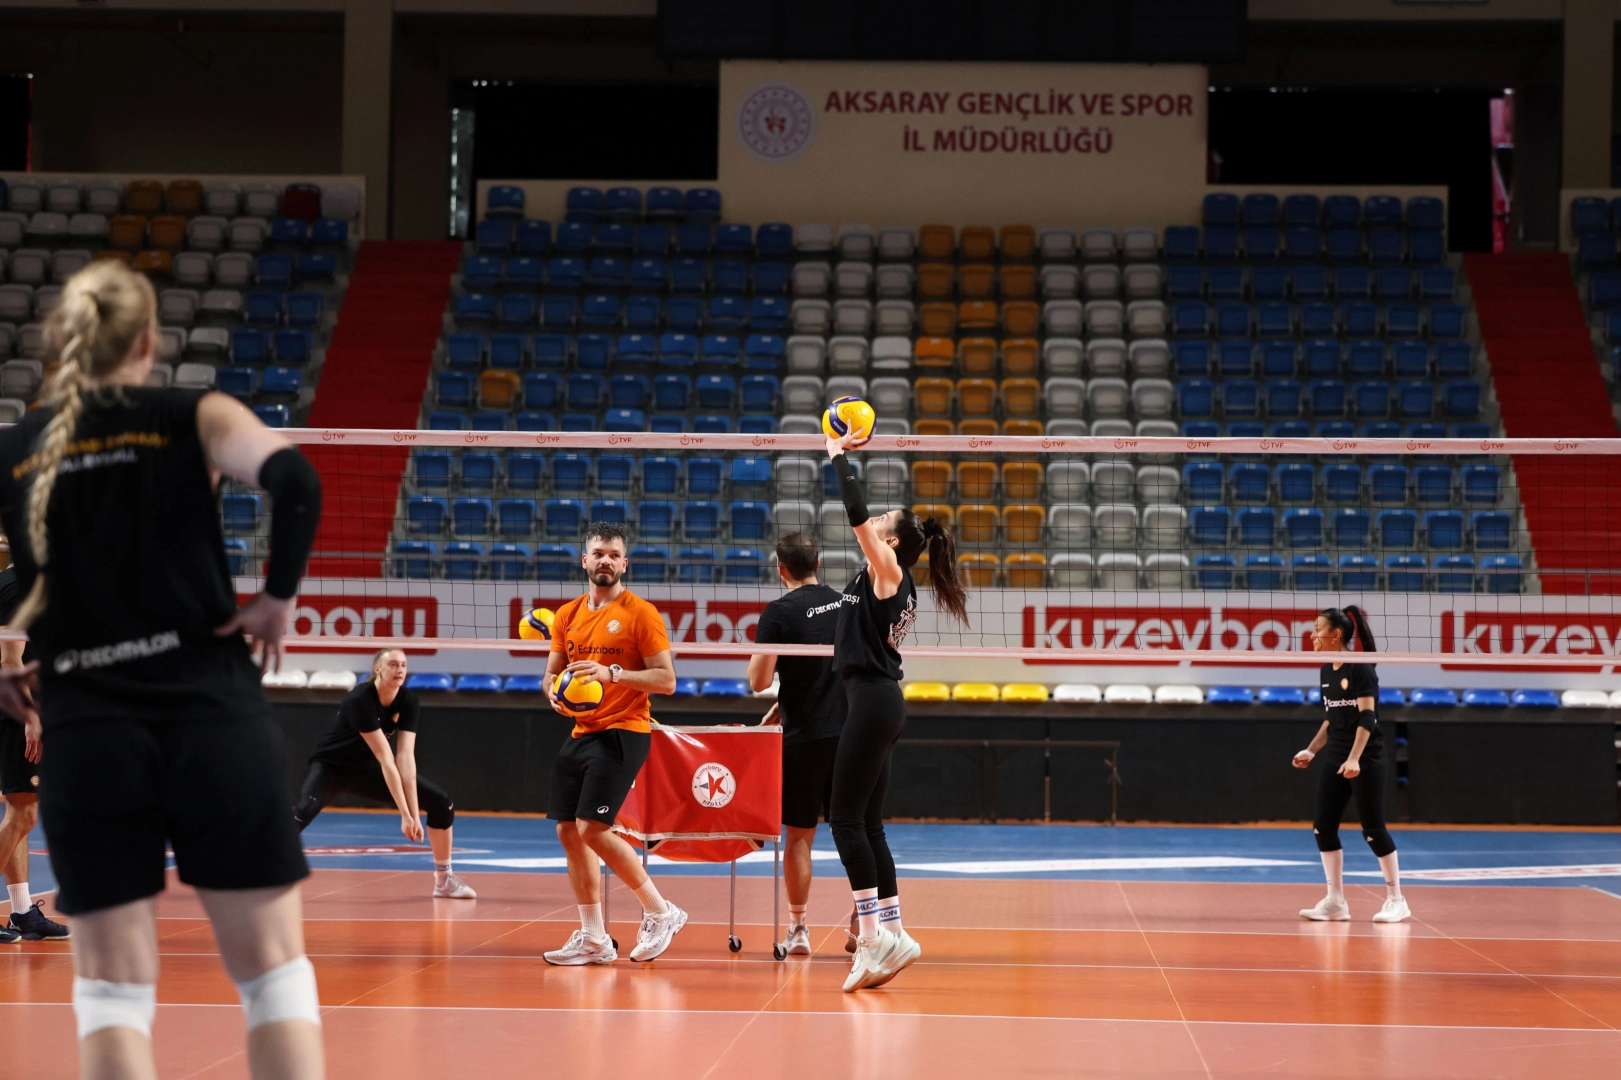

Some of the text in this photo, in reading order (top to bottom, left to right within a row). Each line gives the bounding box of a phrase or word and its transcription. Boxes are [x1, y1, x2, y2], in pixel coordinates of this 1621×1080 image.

[824, 88, 1194, 121] AKSARAY GENÇLİK VE SPOR
[903, 125, 1114, 155] İL MÜDÜRLÜĞÜ
[815, 599, 842, 615] DECATHL
[1034, 605, 1313, 668] kuzeybor
